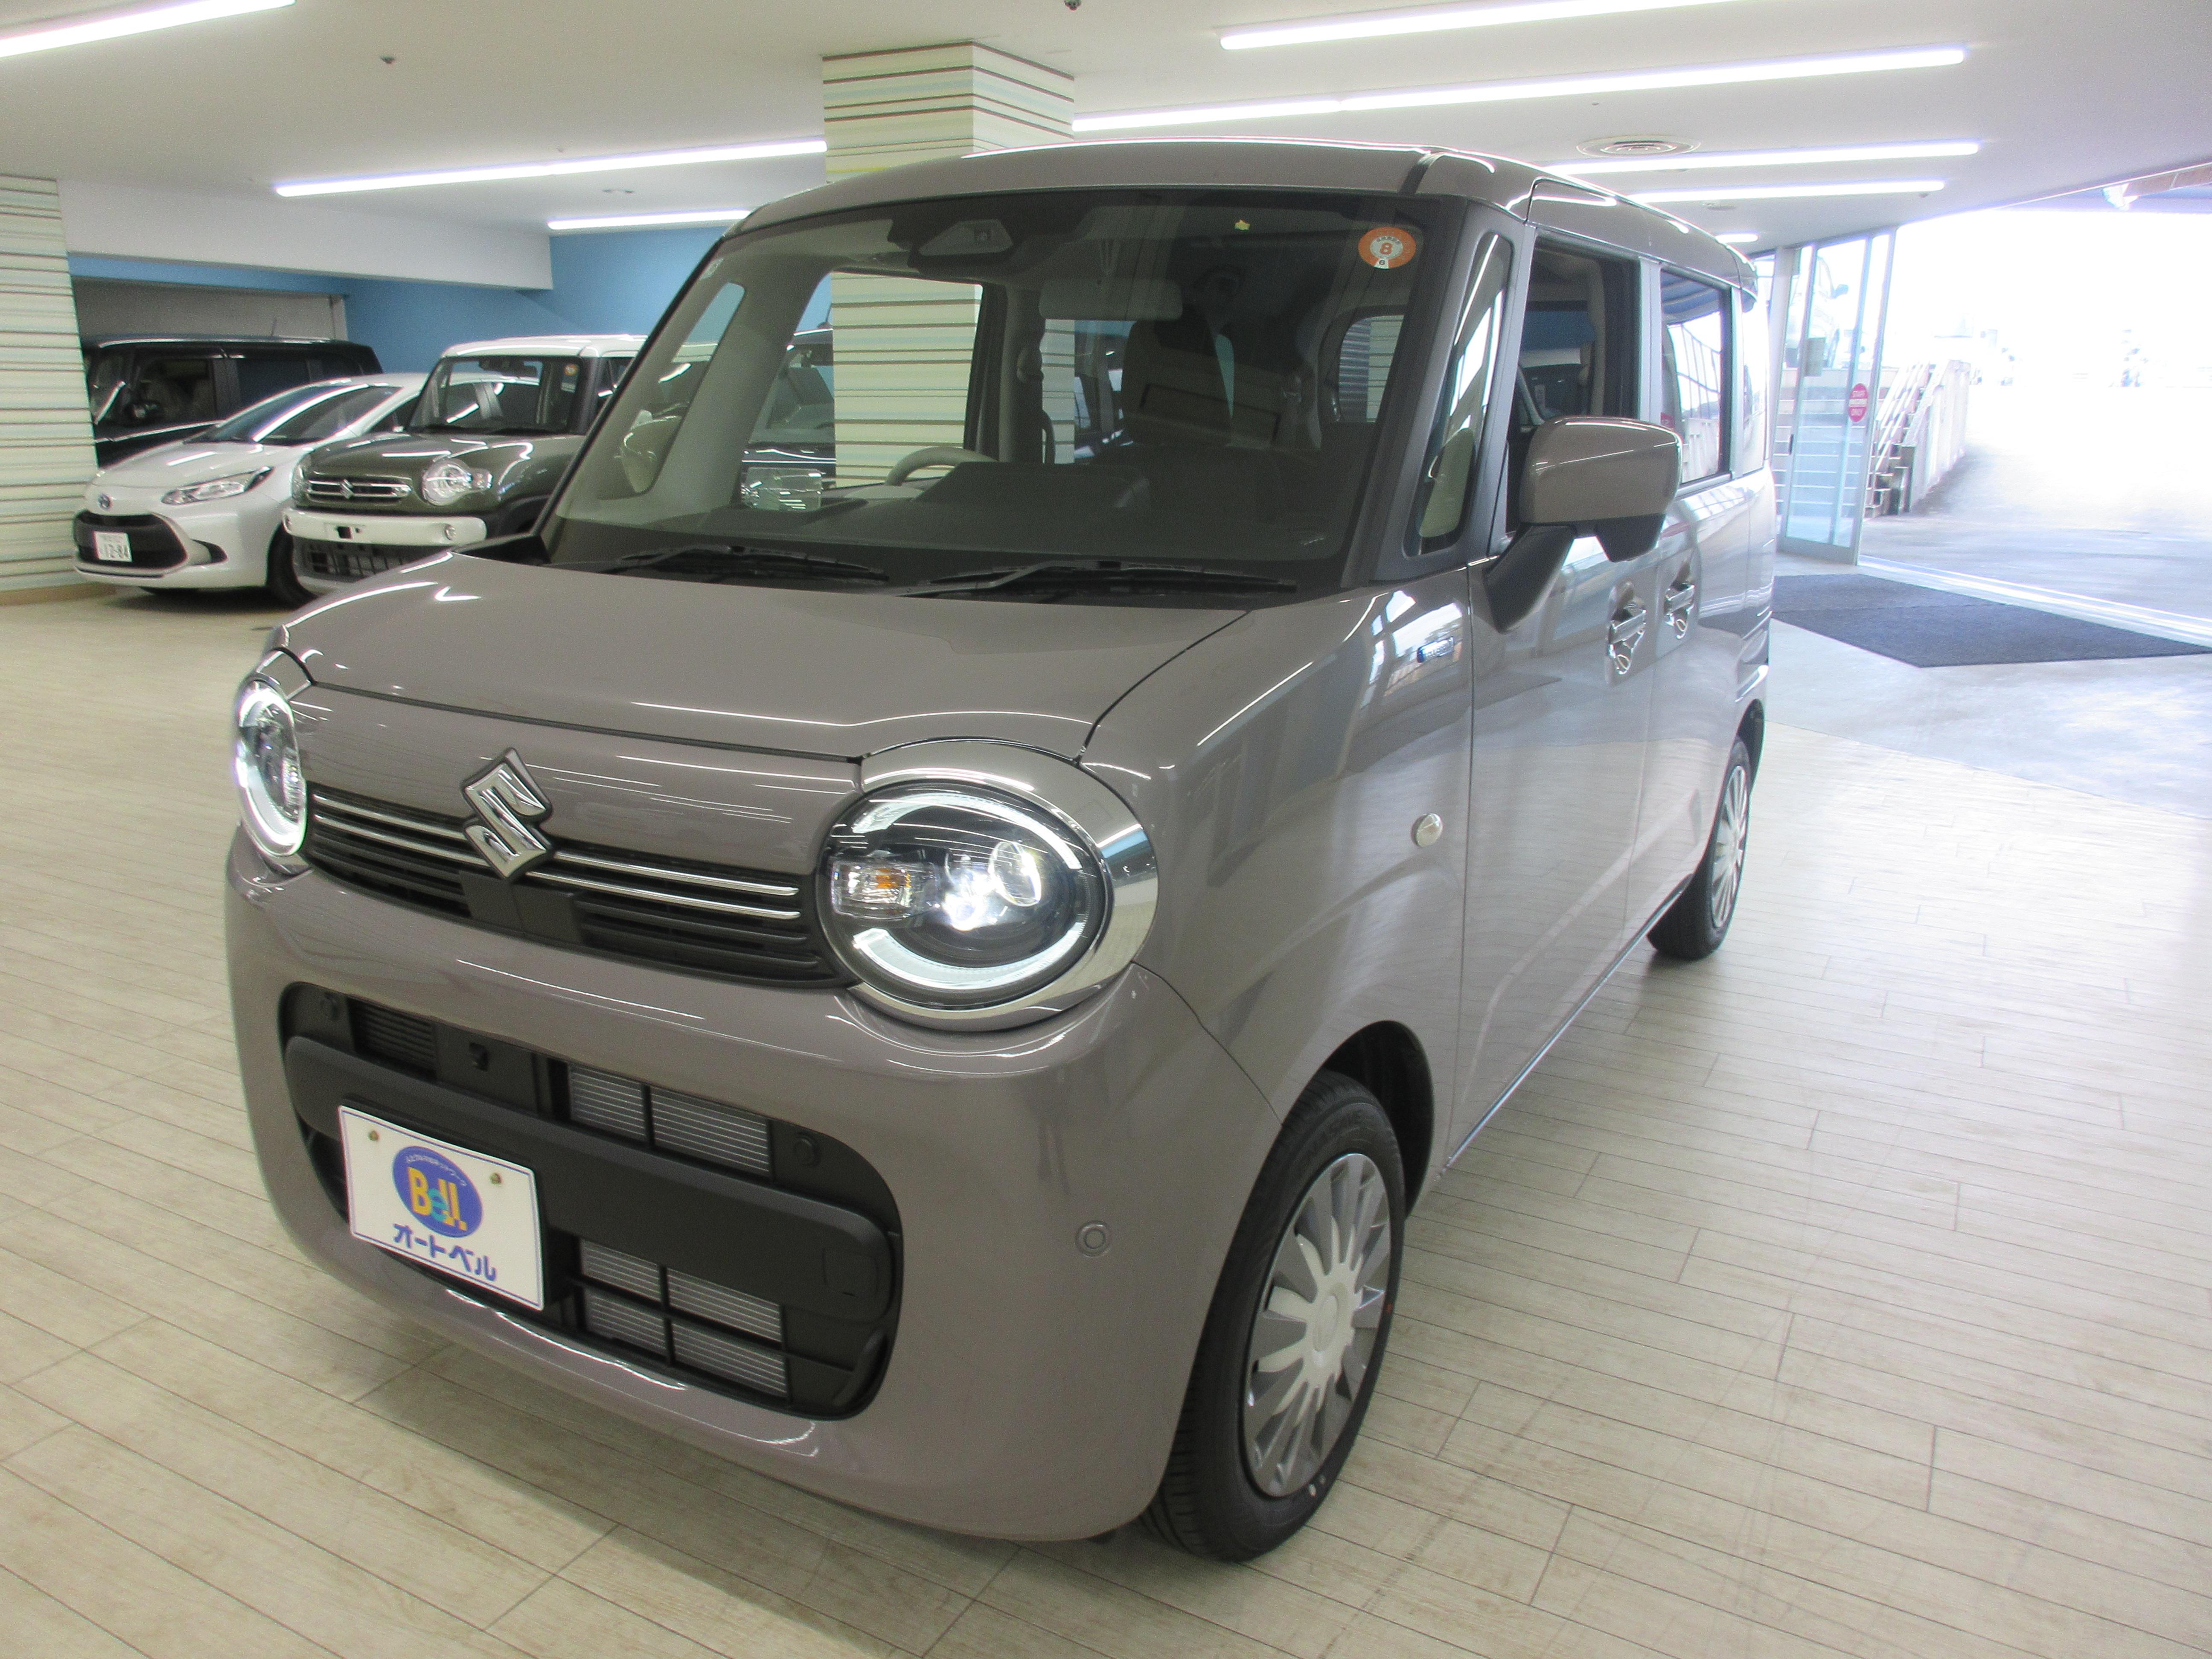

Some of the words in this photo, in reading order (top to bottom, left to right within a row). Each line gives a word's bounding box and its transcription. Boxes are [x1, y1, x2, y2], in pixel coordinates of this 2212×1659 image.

[1380, 242, 1392, 255] 8
[393, 1223, 496, 1282] オートベル
